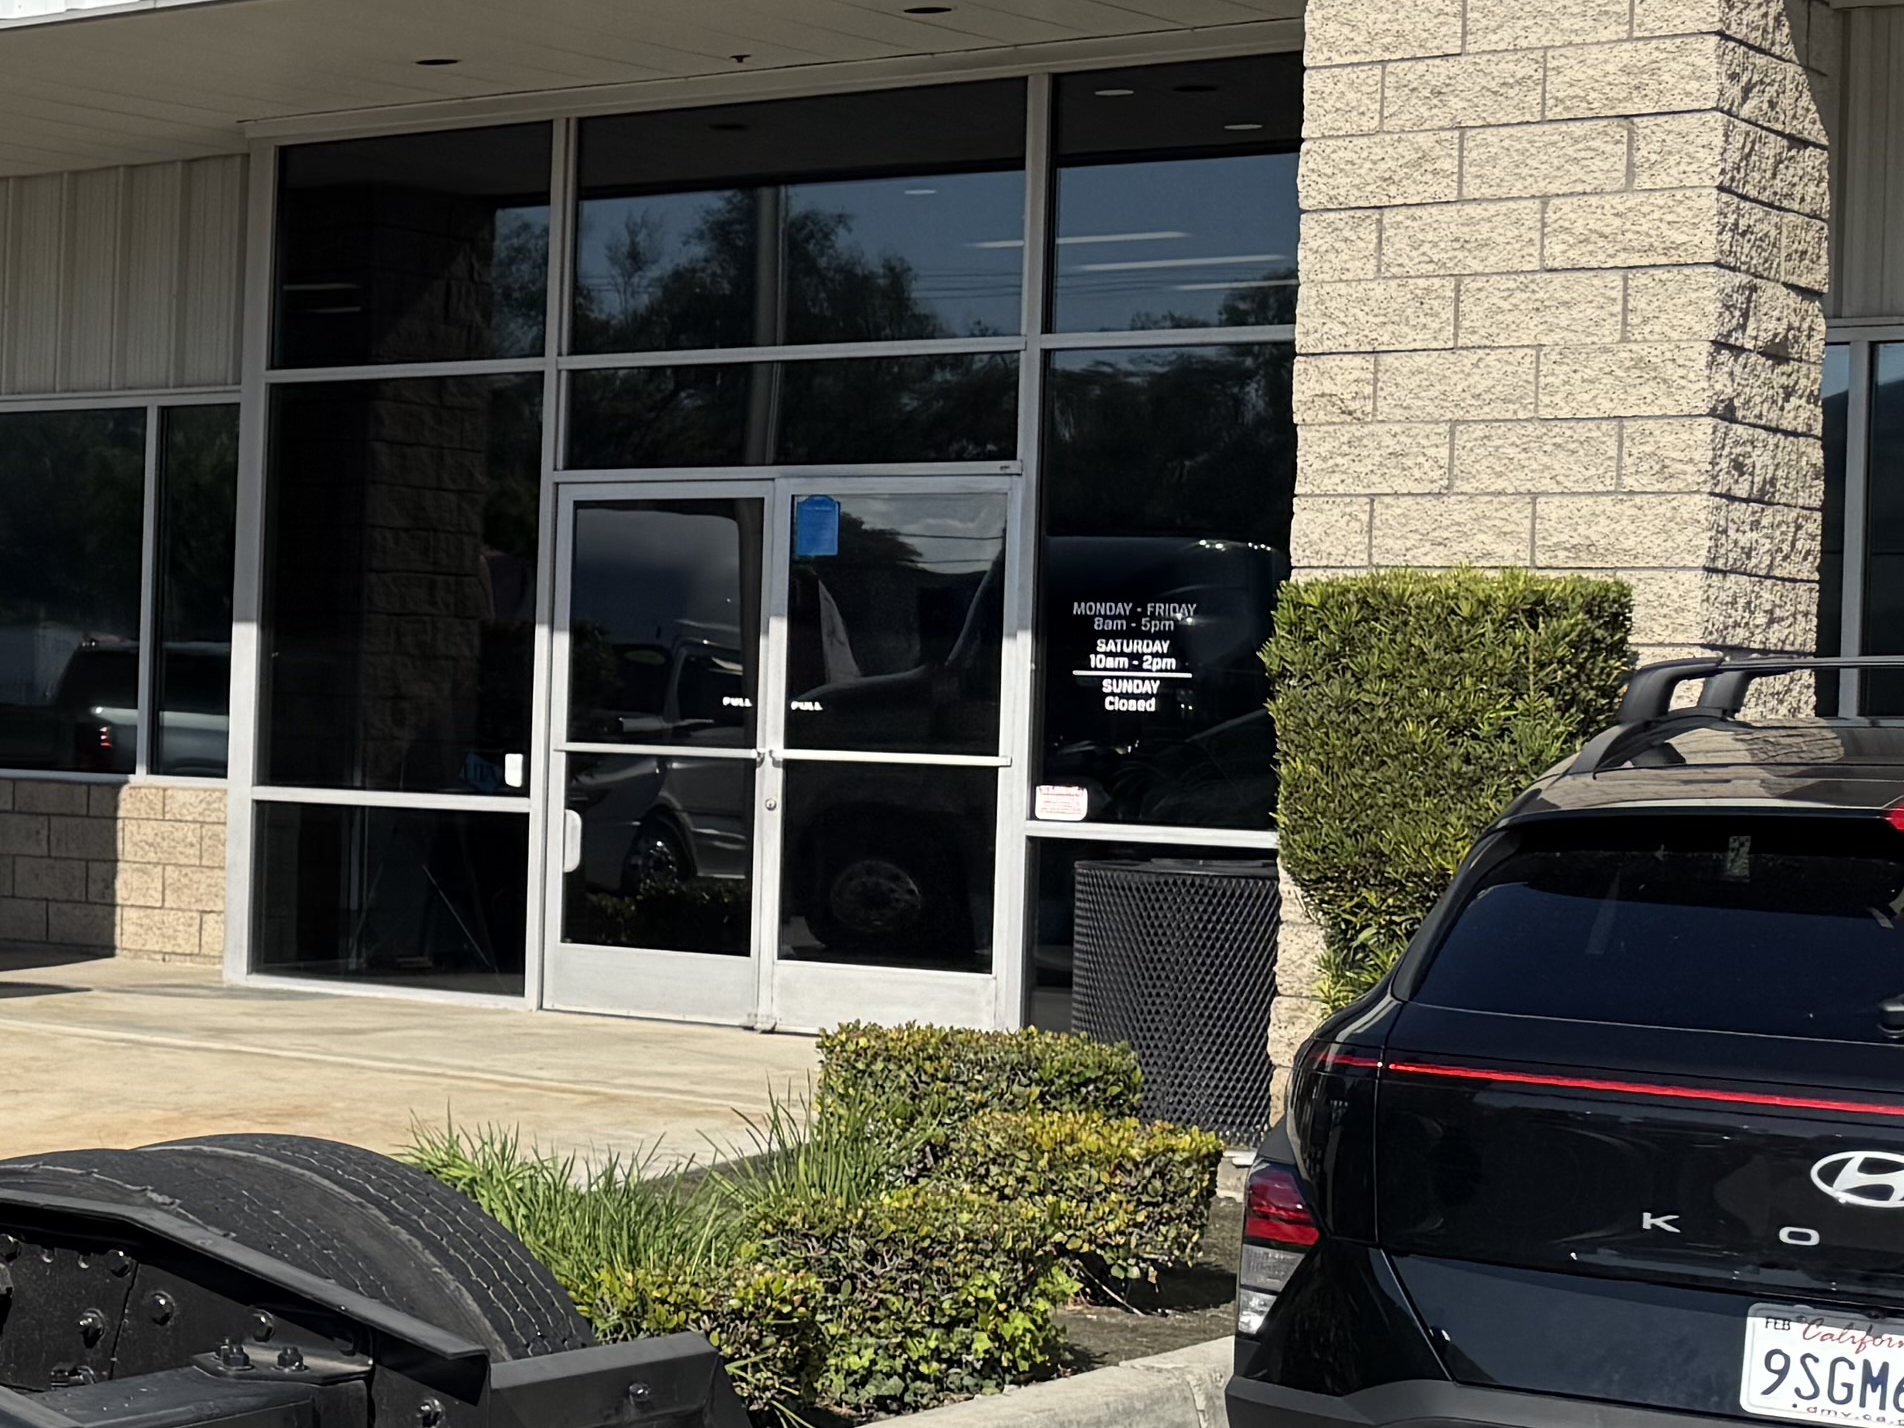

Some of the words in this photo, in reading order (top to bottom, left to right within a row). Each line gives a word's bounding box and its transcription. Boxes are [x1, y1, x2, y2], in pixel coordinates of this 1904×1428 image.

[1073, 602, 1133, 616] MONDAY
[1147, 603, 1197, 617] FRIDAY
[1094, 617, 1126, 631] 8am
[1141, 617, 1174, 633] 5pm
[1096, 639, 1170, 654] SATURDAY
[1089, 654, 1129, 669] 10am
[1142, 655, 1176, 671] 2pm
[1102, 679, 1160, 694] SUNDAY
[1104, 696, 1156, 712] Closed
[1765, 1316, 1791, 1331] FEB
